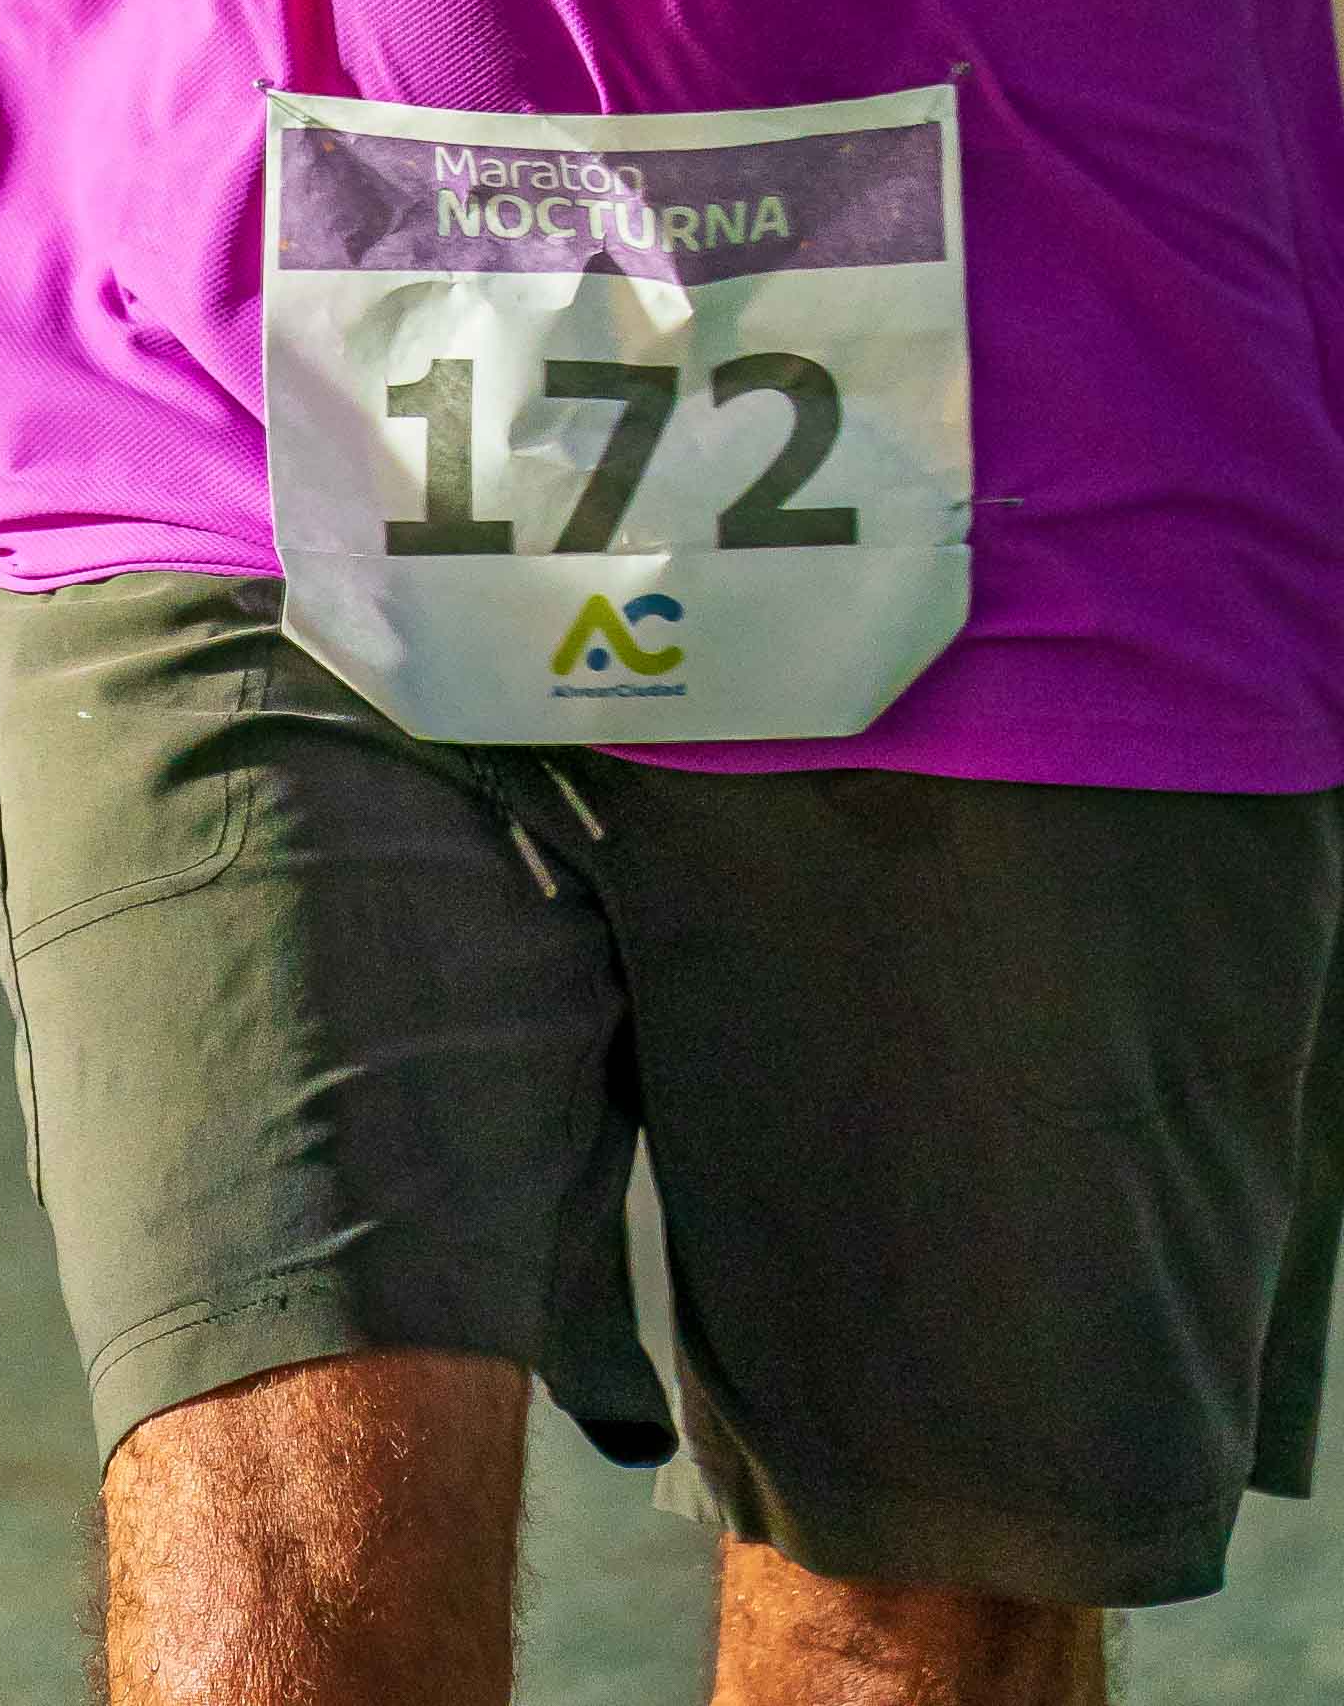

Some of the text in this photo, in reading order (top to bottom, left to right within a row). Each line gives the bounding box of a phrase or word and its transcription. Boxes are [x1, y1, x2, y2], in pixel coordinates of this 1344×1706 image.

[435, 145, 644, 196] Maratón
[437, 188, 789, 253] NOCTURNA
[384, 351, 860, 556] 172
